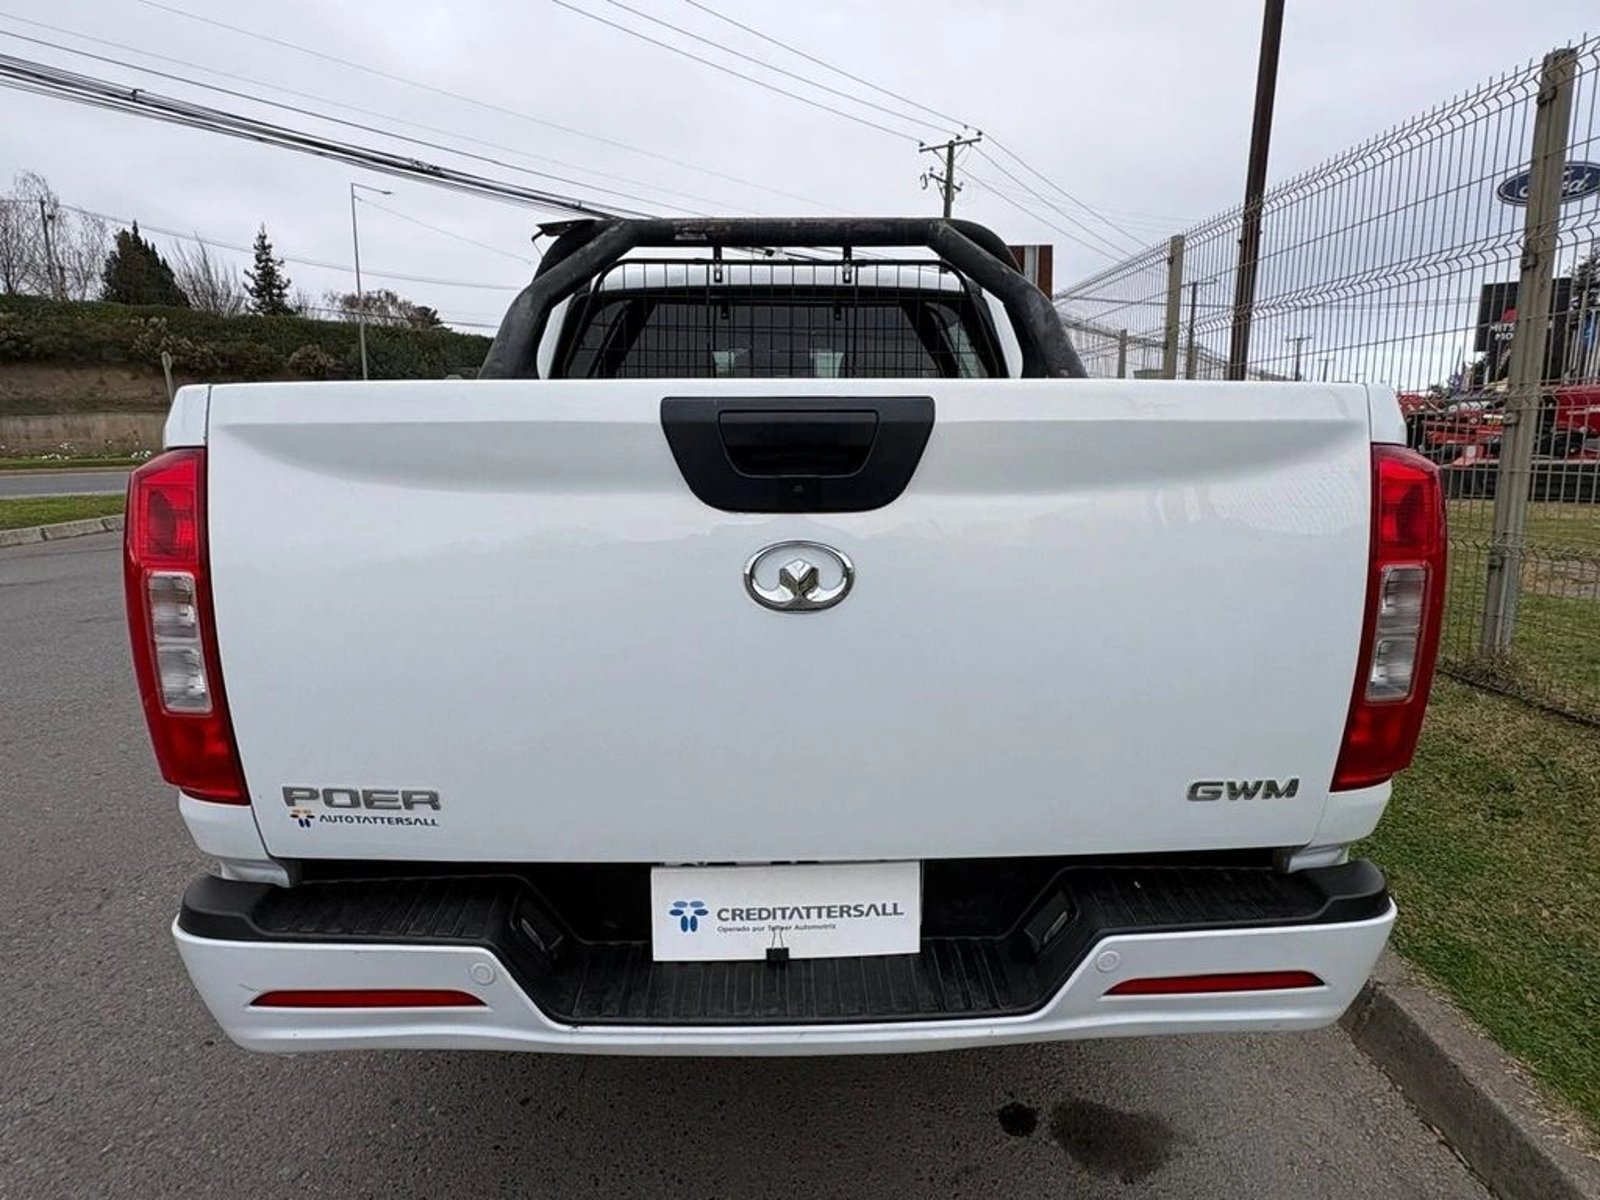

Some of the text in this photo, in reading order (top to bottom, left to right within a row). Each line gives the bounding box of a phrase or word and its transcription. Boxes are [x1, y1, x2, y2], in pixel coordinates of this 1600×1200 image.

[282, 786, 441, 811] POER
[1186, 778, 1300, 801] GWM
[319, 814, 440, 827] AUTOTATTERSALL
[716, 902, 905, 922] CREDITATTERSALL
[716, 924, 751, 934] Operado
[752, 925, 765, 933] por
